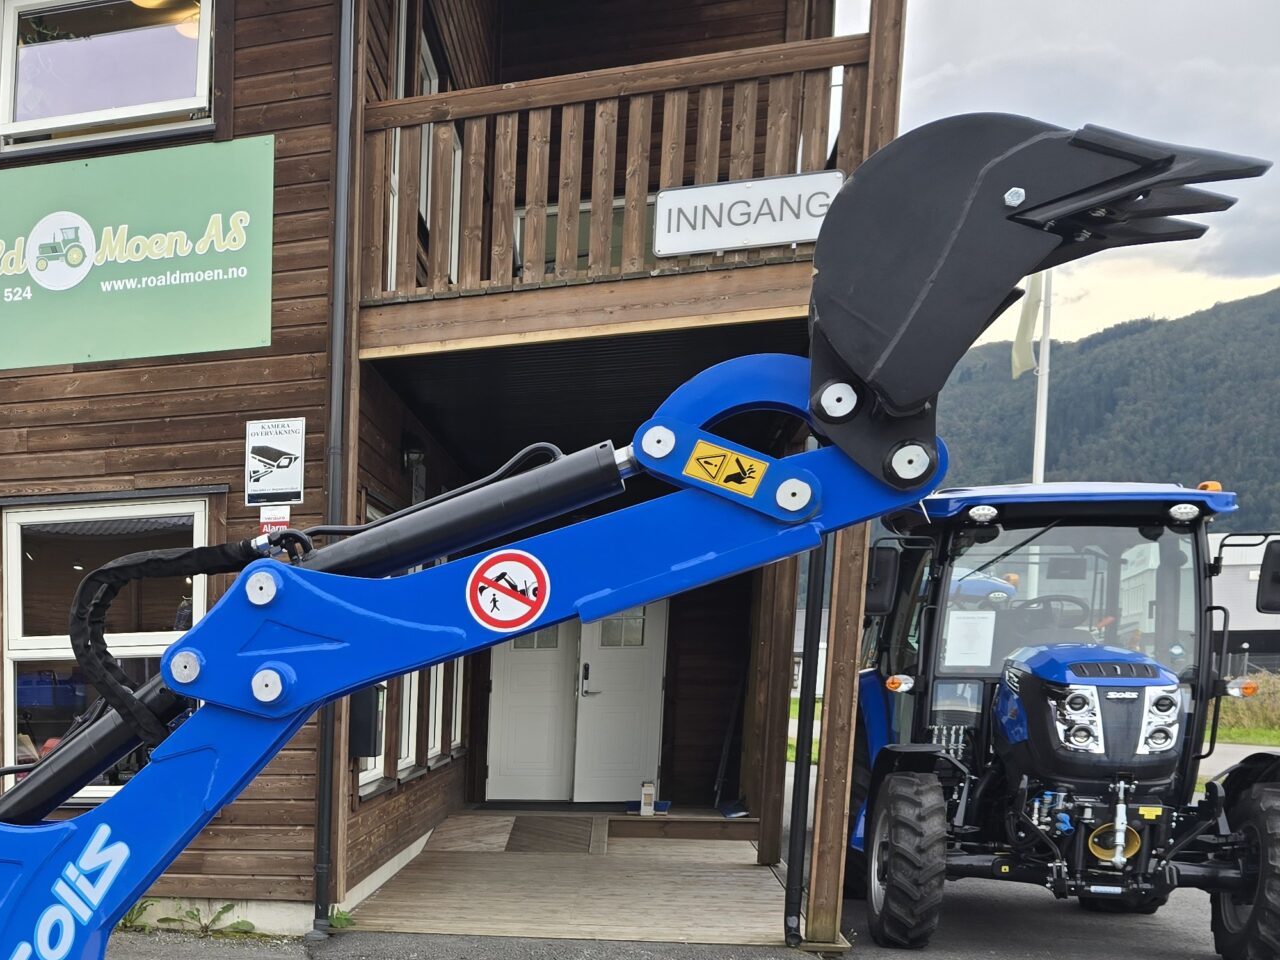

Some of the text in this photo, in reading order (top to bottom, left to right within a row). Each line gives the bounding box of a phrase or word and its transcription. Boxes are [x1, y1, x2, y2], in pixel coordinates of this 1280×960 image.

[665, 191, 830, 234] INNGANG
[94, 222, 192, 267] Moen
[195, 210, 251, 255] AS
[100, 267, 248, 293] www.roaldmoen.no
[3, 286, 32, 303] 524
[250, 429, 300, 437] OVERVÅKNING
[262, 524, 288, 533] Alarm
